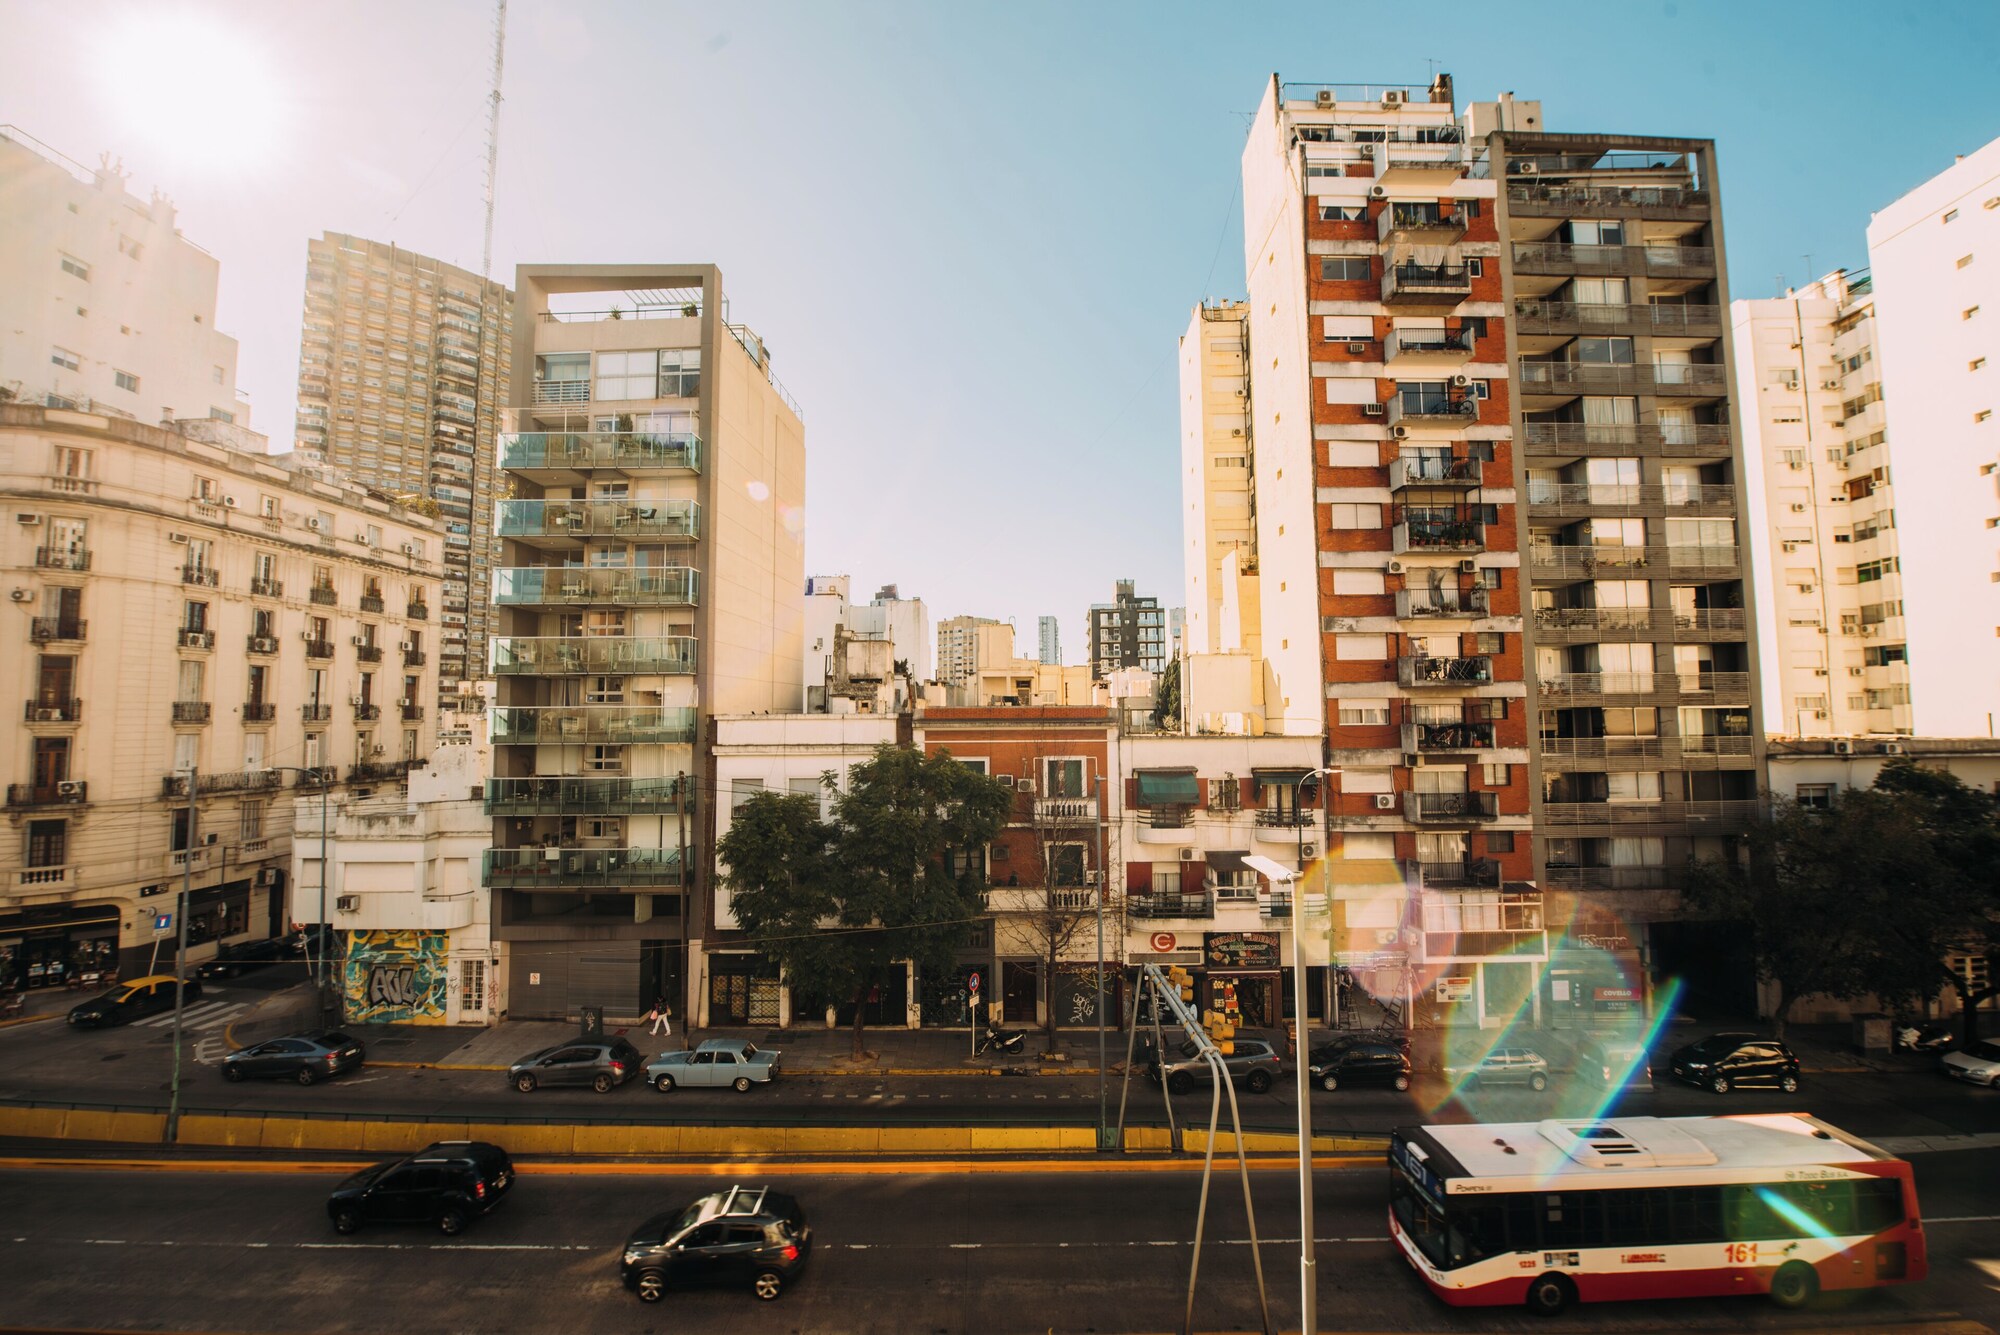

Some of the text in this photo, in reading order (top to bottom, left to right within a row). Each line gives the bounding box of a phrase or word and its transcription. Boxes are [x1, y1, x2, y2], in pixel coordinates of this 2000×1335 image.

[1603, 989, 1632, 997] COVELLO
[1404, 1149, 1427, 1186] 161
[1724, 1242, 1758, 1264] 161
